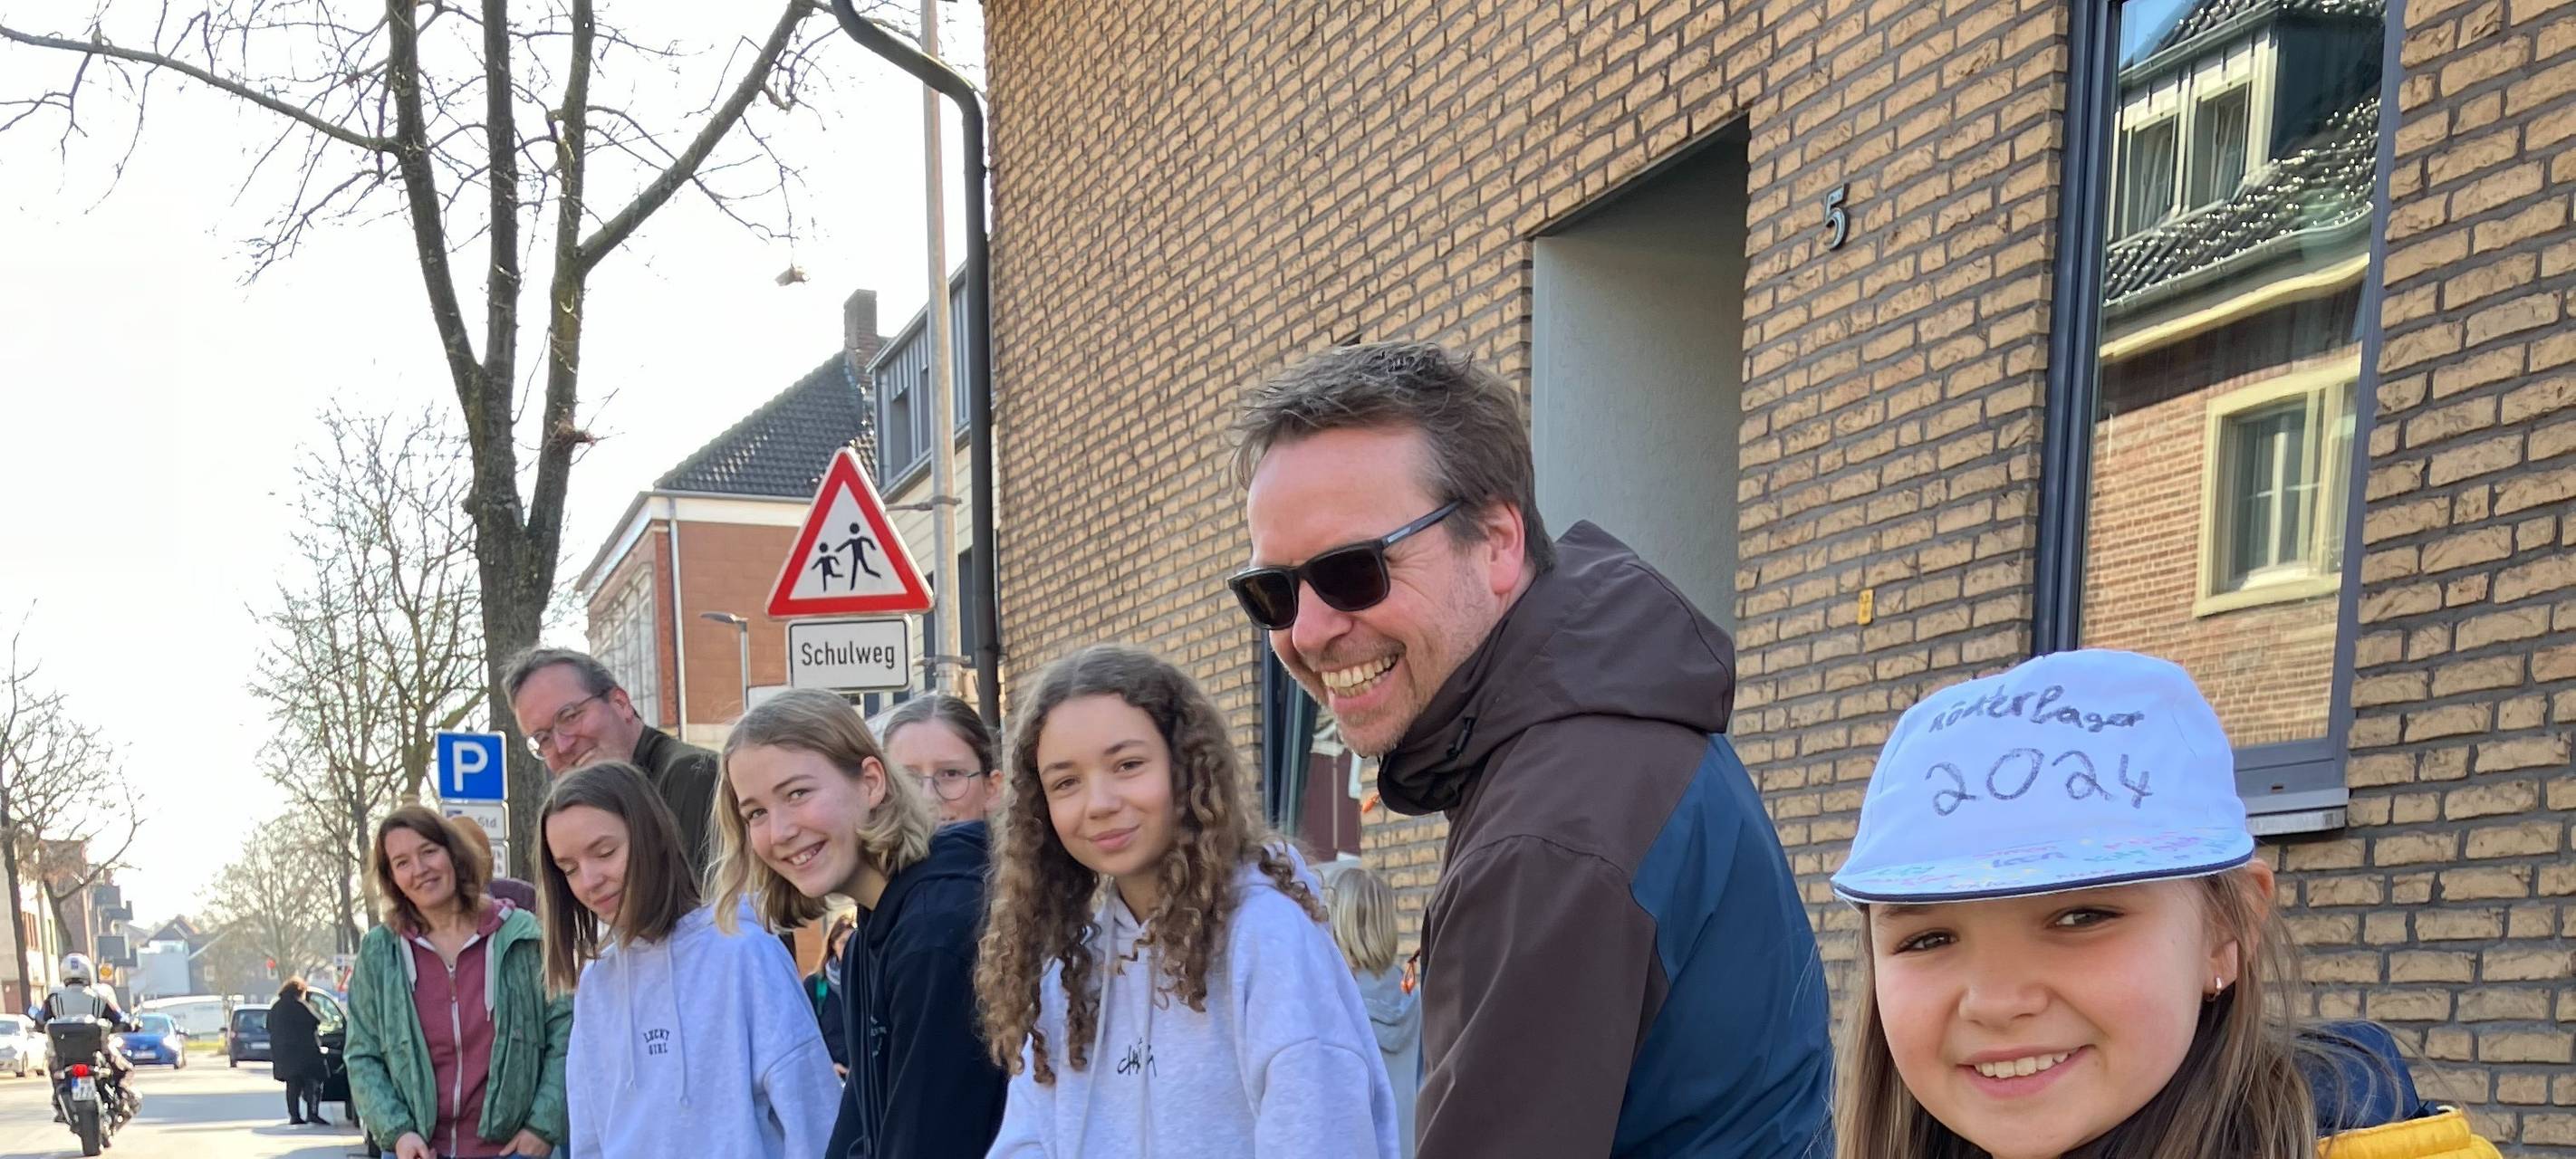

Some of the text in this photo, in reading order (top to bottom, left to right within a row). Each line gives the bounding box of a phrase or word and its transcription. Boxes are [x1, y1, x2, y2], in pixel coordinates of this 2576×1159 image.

[1824, 183, 1849, 251] 5
[801, 640, 895, 670] Schulweg
[453, 741, 489, 792] P
[1924, 747, 2155, 817] 2024
[643, 1029, 670, 1043] LUCKY
[649, 1043, 668, 1056] GIRL
